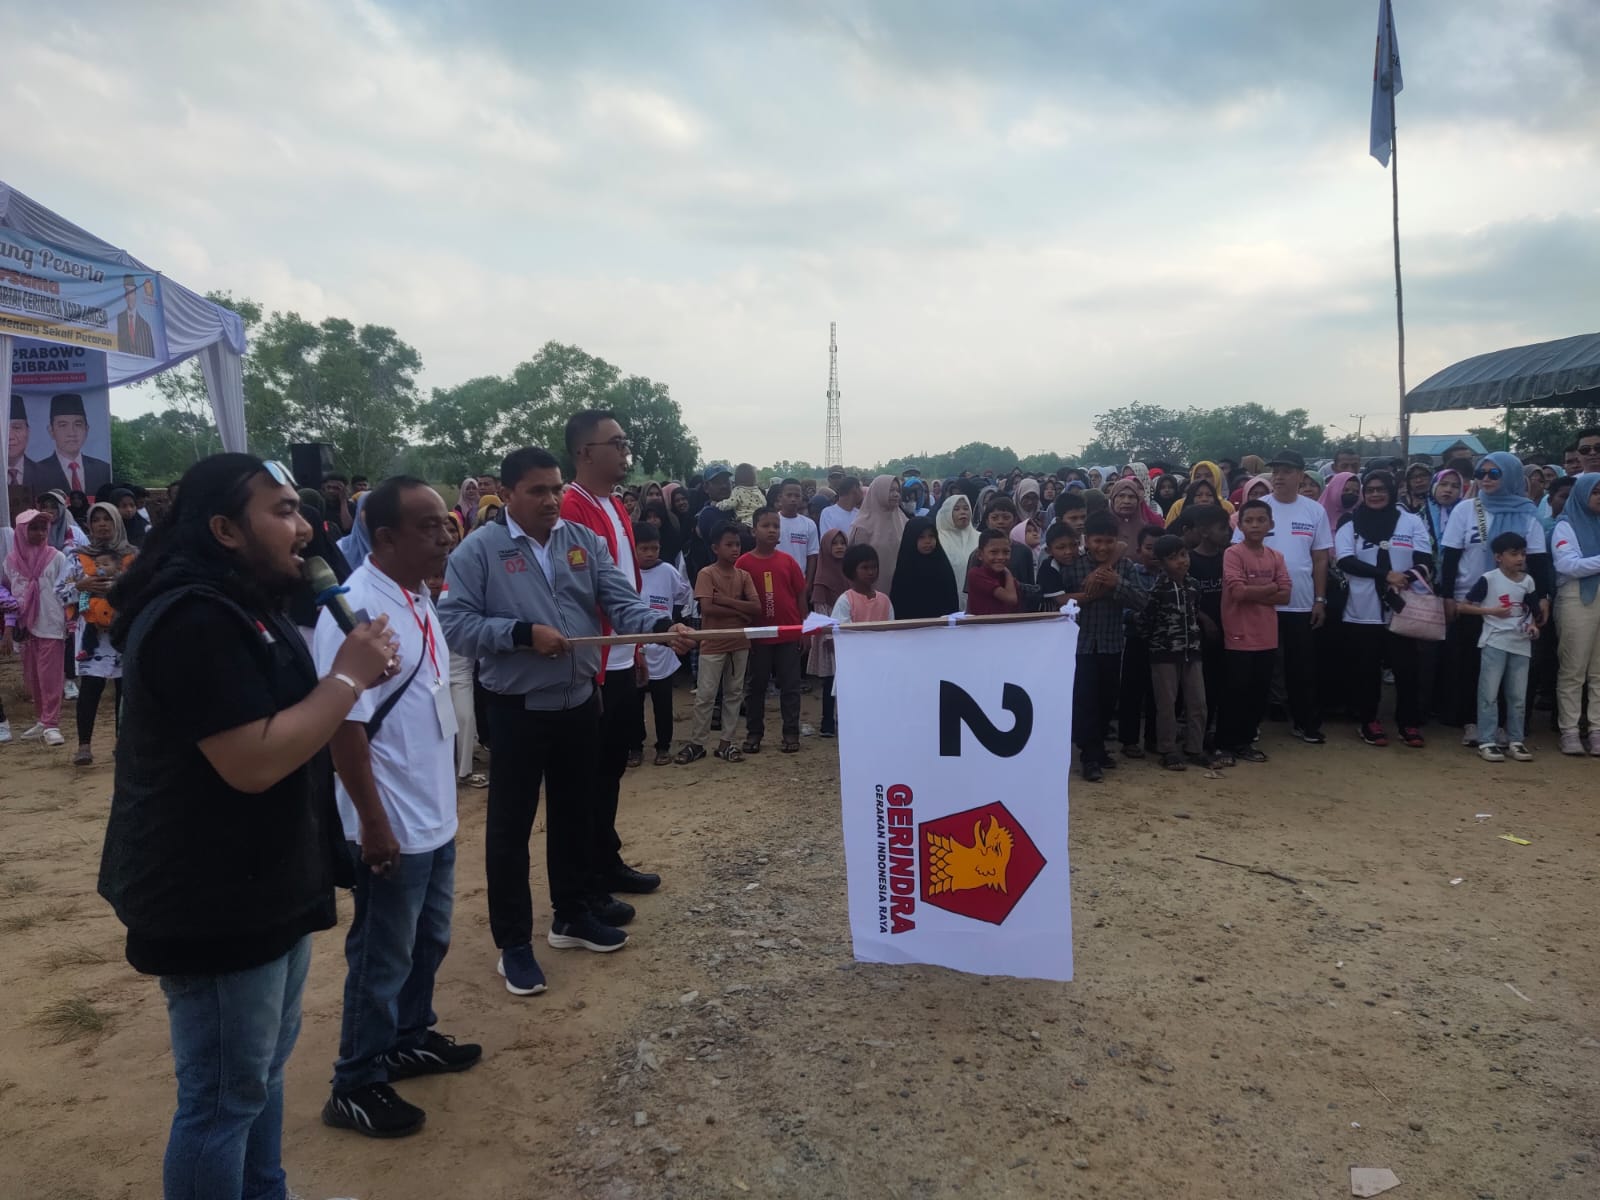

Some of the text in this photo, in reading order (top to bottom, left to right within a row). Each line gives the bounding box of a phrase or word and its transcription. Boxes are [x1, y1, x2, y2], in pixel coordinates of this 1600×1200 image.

[38, 248, 105, 284] Peserta
[22, 290, 62, 319] GERINDRA
[42, 324, 73, 340] Sekali
[75, 331, 112, 346] Putaran
[12, 360, 69, 373] GIBRAN
[13, 347, 86, 359] PRABOWO
[505, 559, 527, 573] 02
[940, 680, 1034, 758] 2
[875, 784, 888, 934] GERAKAN INDONESIA RAYA
[886, 783, 916, 935] GERINDRA
